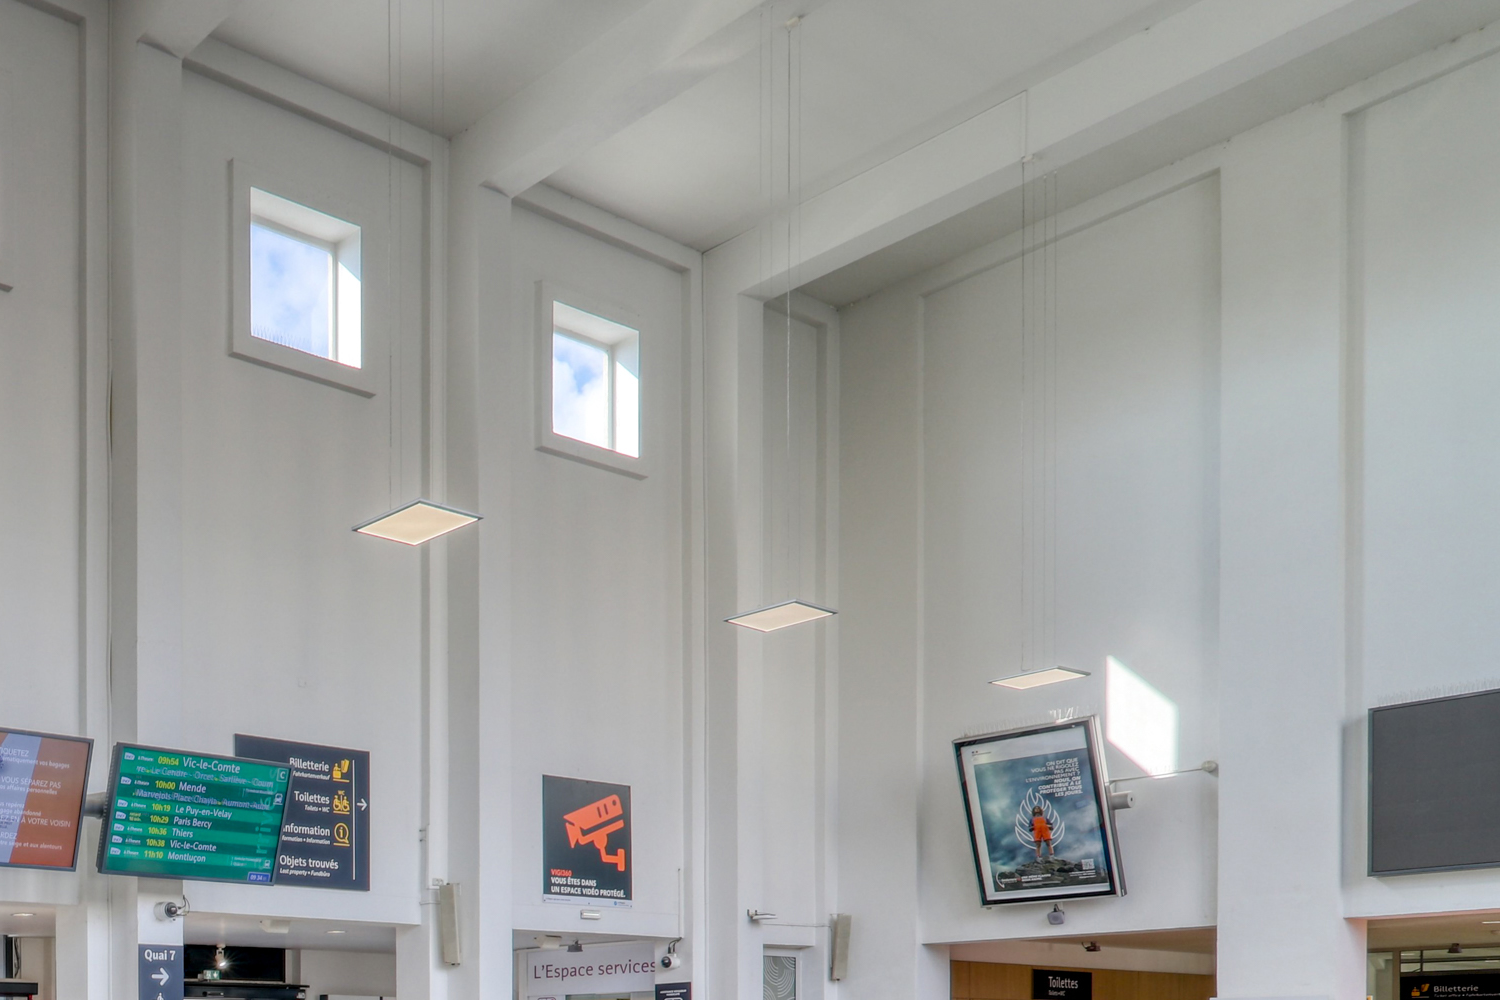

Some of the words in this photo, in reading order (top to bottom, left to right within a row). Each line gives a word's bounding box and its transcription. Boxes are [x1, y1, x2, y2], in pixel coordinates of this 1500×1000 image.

[183, 757, 240, 773] Vic-le-Comte
[280, 771, 285, 779] C
[1, 775, 19, 784] VOUS
[21, 777, 48, 787] SÉPAREZ
[49, 781, 61, 789] PAS
[179, 781, 206, 793] Mende
[293, 791, 330, 804] Toilettes
[175, 805, 184, 813] Le
[186, 806, 232, 820] Puy-en-Velay
[28, 817, 48, 826] VOTRE
[49, 819, 71, 828] VOISIN
[173, 816, 191, 826] Paris
[192, 818, 212, 829] Bercy
[172, 828, 193, 838] Thiers
[283, 823, 330, 836] nformation
[170, 840, 217, 852] Vic-le-Comte
[168, 851, 206, 863] Montluçon
[279, 854, 307, 868] Objets
[308, 859, 339, 870] trouvés
[551, 876, 566, 884] VOUS
[567, 877, 580, 886] ÊTES
[581, 879, 597, 887] DANS
[561, 886, 581, 894] ESPACE
[582, 886, 599, 896] VIDÉO
[144, 949, 167, 962] Quai
[169, 950, 176, 961] 7
[534, 964, 593, 981] L'Espace
[598, 959, 655, 976] services
[1048, 976, 1078, 989] Toilettes
[1433, 985, 1479, 993] Billetterie
